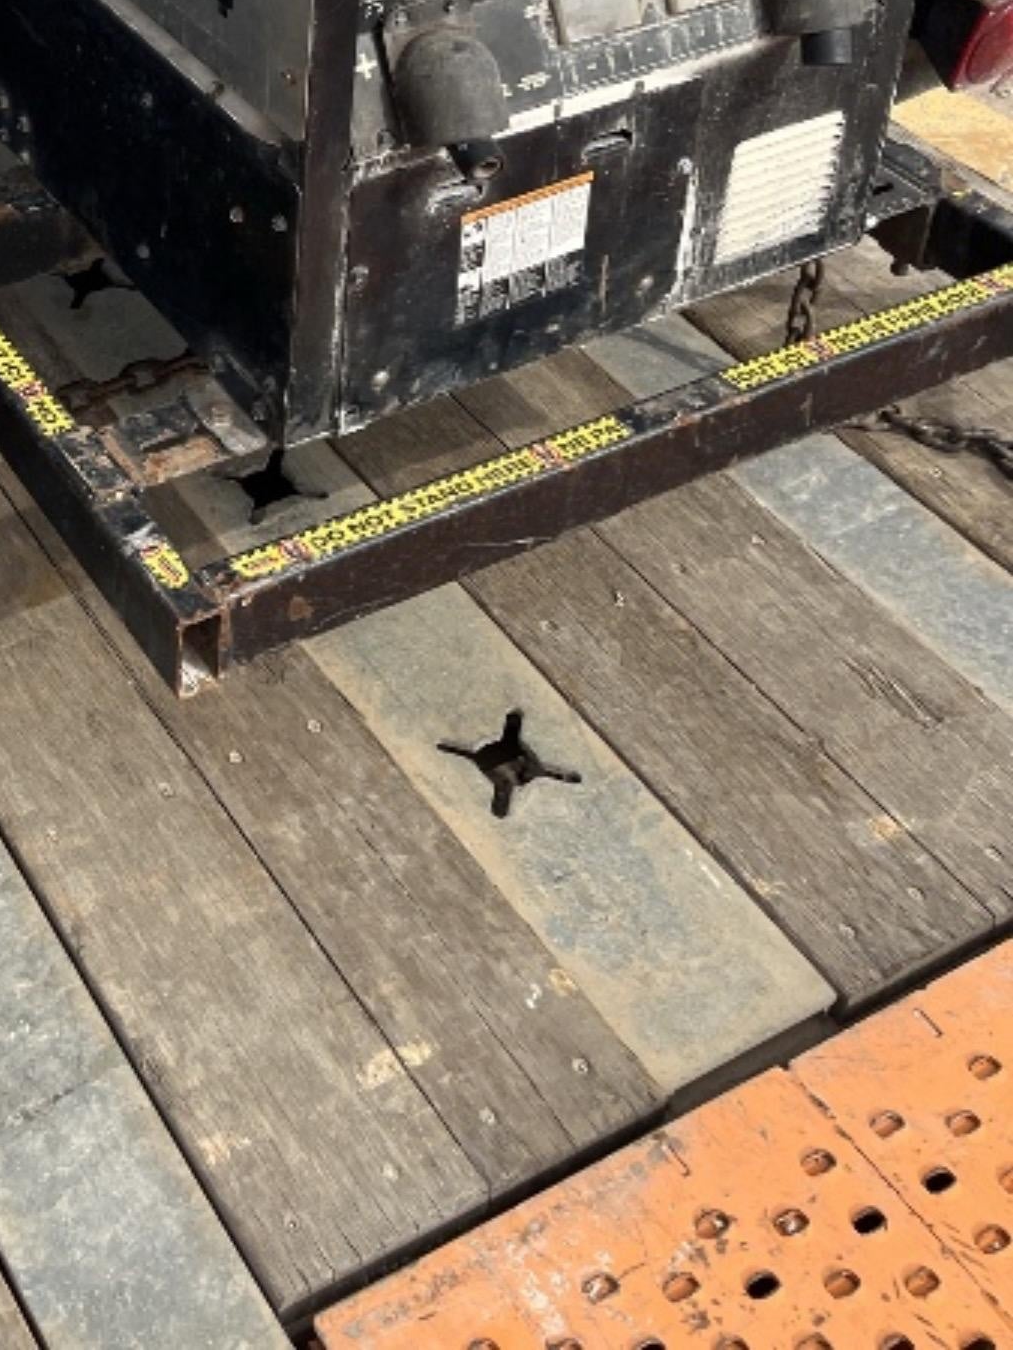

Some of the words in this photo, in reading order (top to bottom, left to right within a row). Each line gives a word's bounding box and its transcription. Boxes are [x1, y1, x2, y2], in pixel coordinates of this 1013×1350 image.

[310, 527, 345, 550] DO
[346, 509, 394, 535] NOT
[397, 478, 475, 515] STAND
[477, 453, 537, 486] HERE
